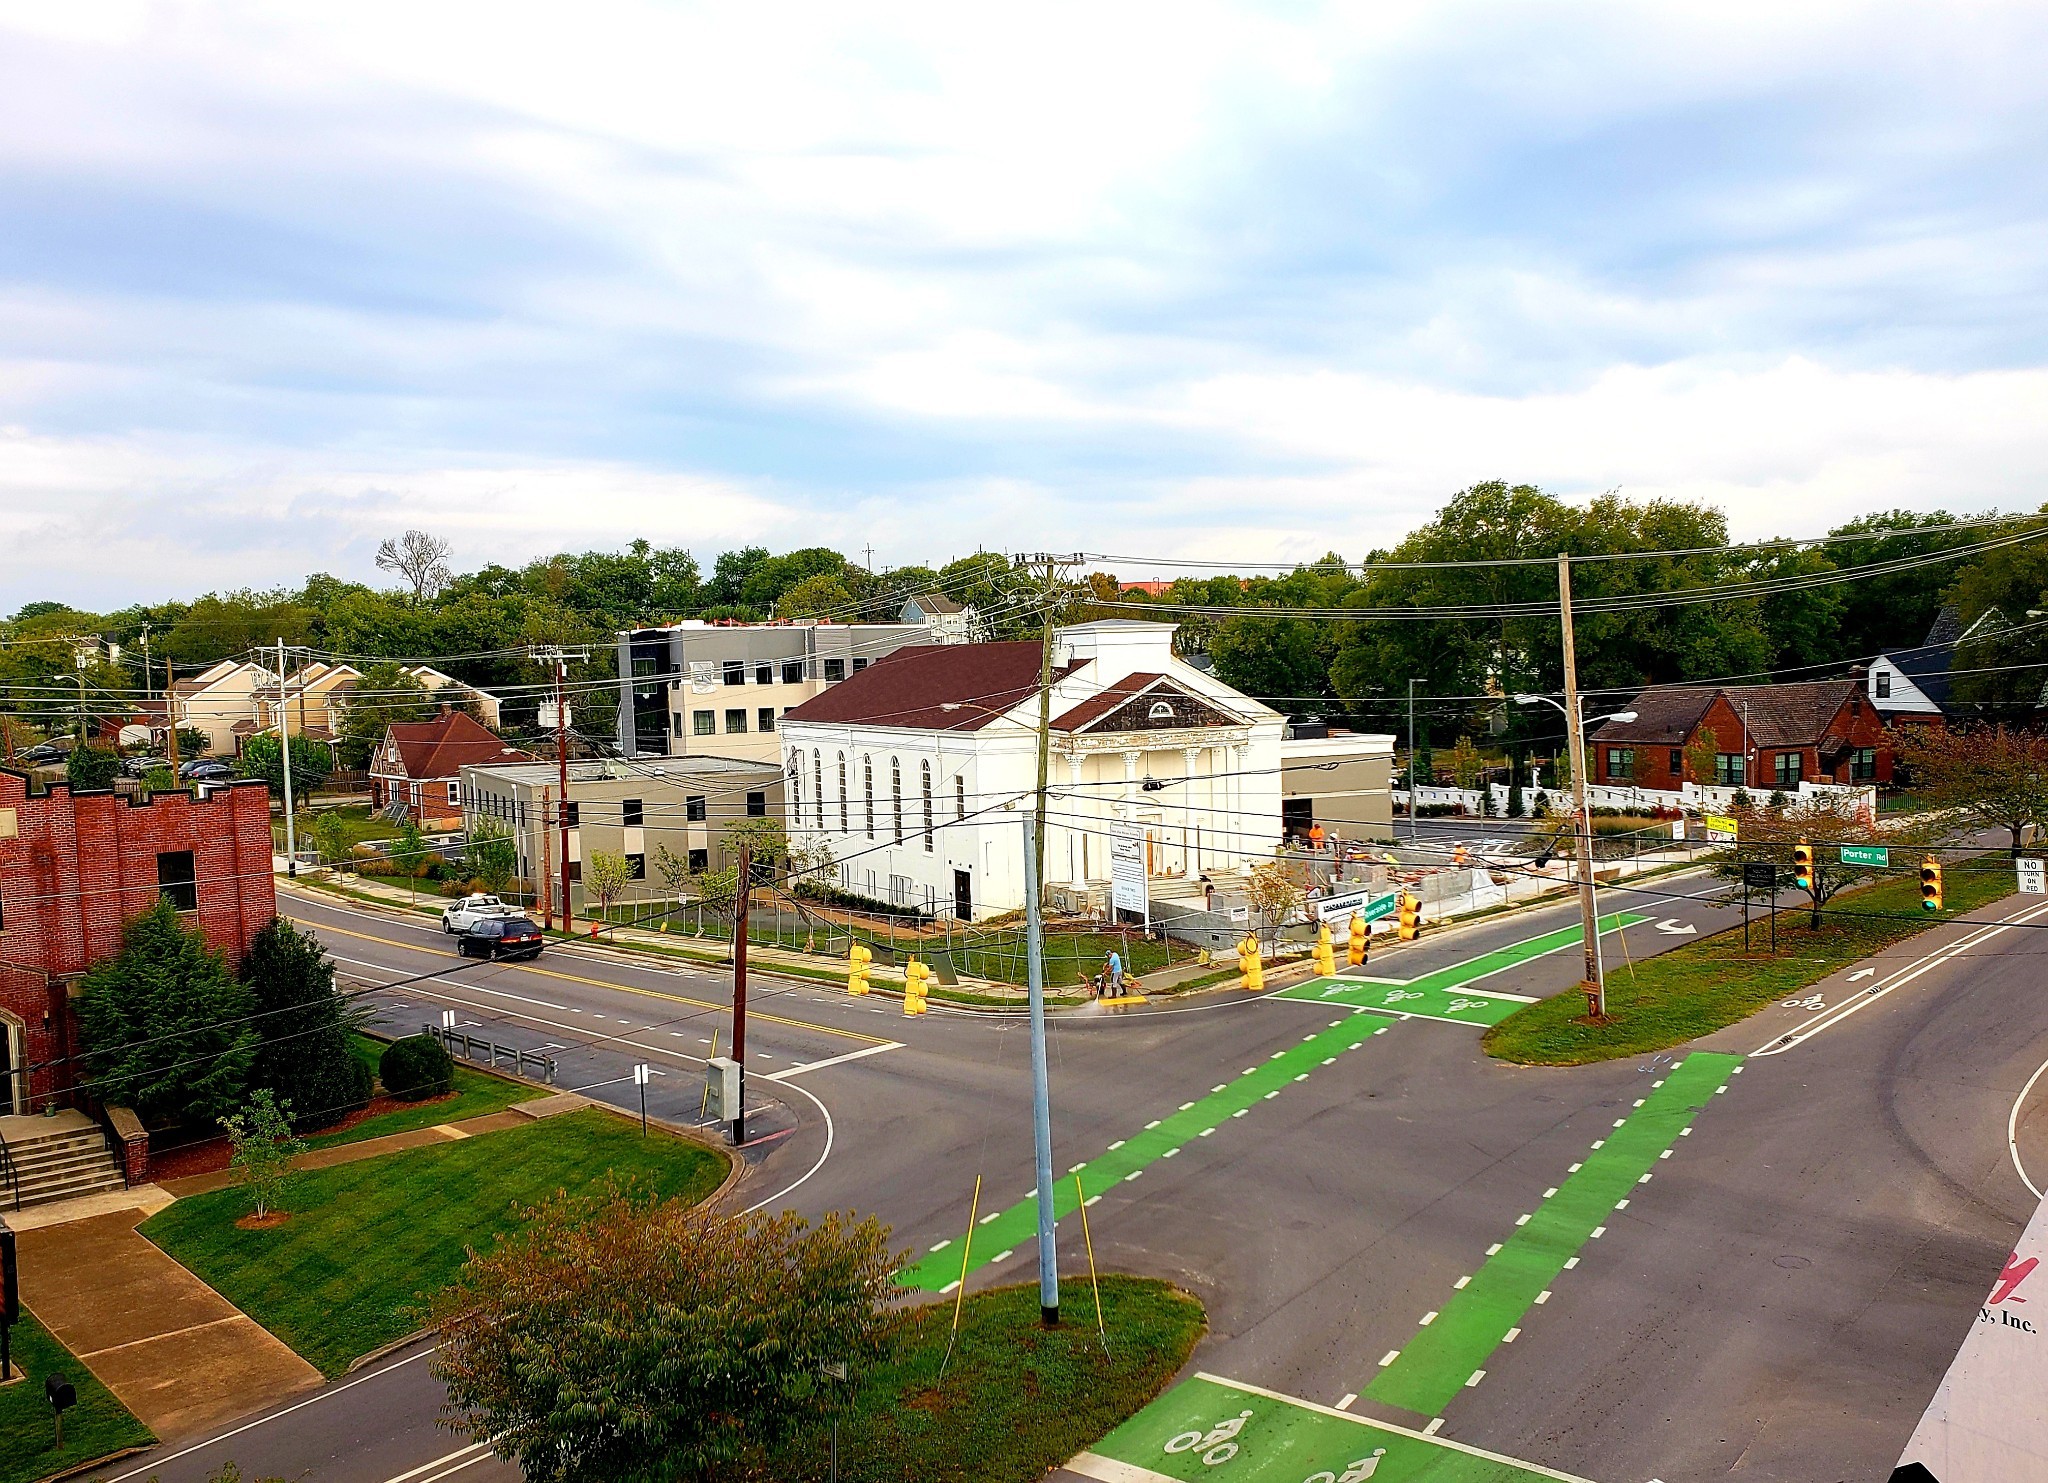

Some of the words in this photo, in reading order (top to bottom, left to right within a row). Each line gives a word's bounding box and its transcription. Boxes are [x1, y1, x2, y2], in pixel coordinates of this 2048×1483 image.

[1843, 848, 1872, 859] Porter
[1876, 853, 1886, 861] Rd
[2024, 861, 2037, 869] NO
[1978, 1307, 1996, 1324] y,
[2001, 1309, 2037, 1334] Inc.
